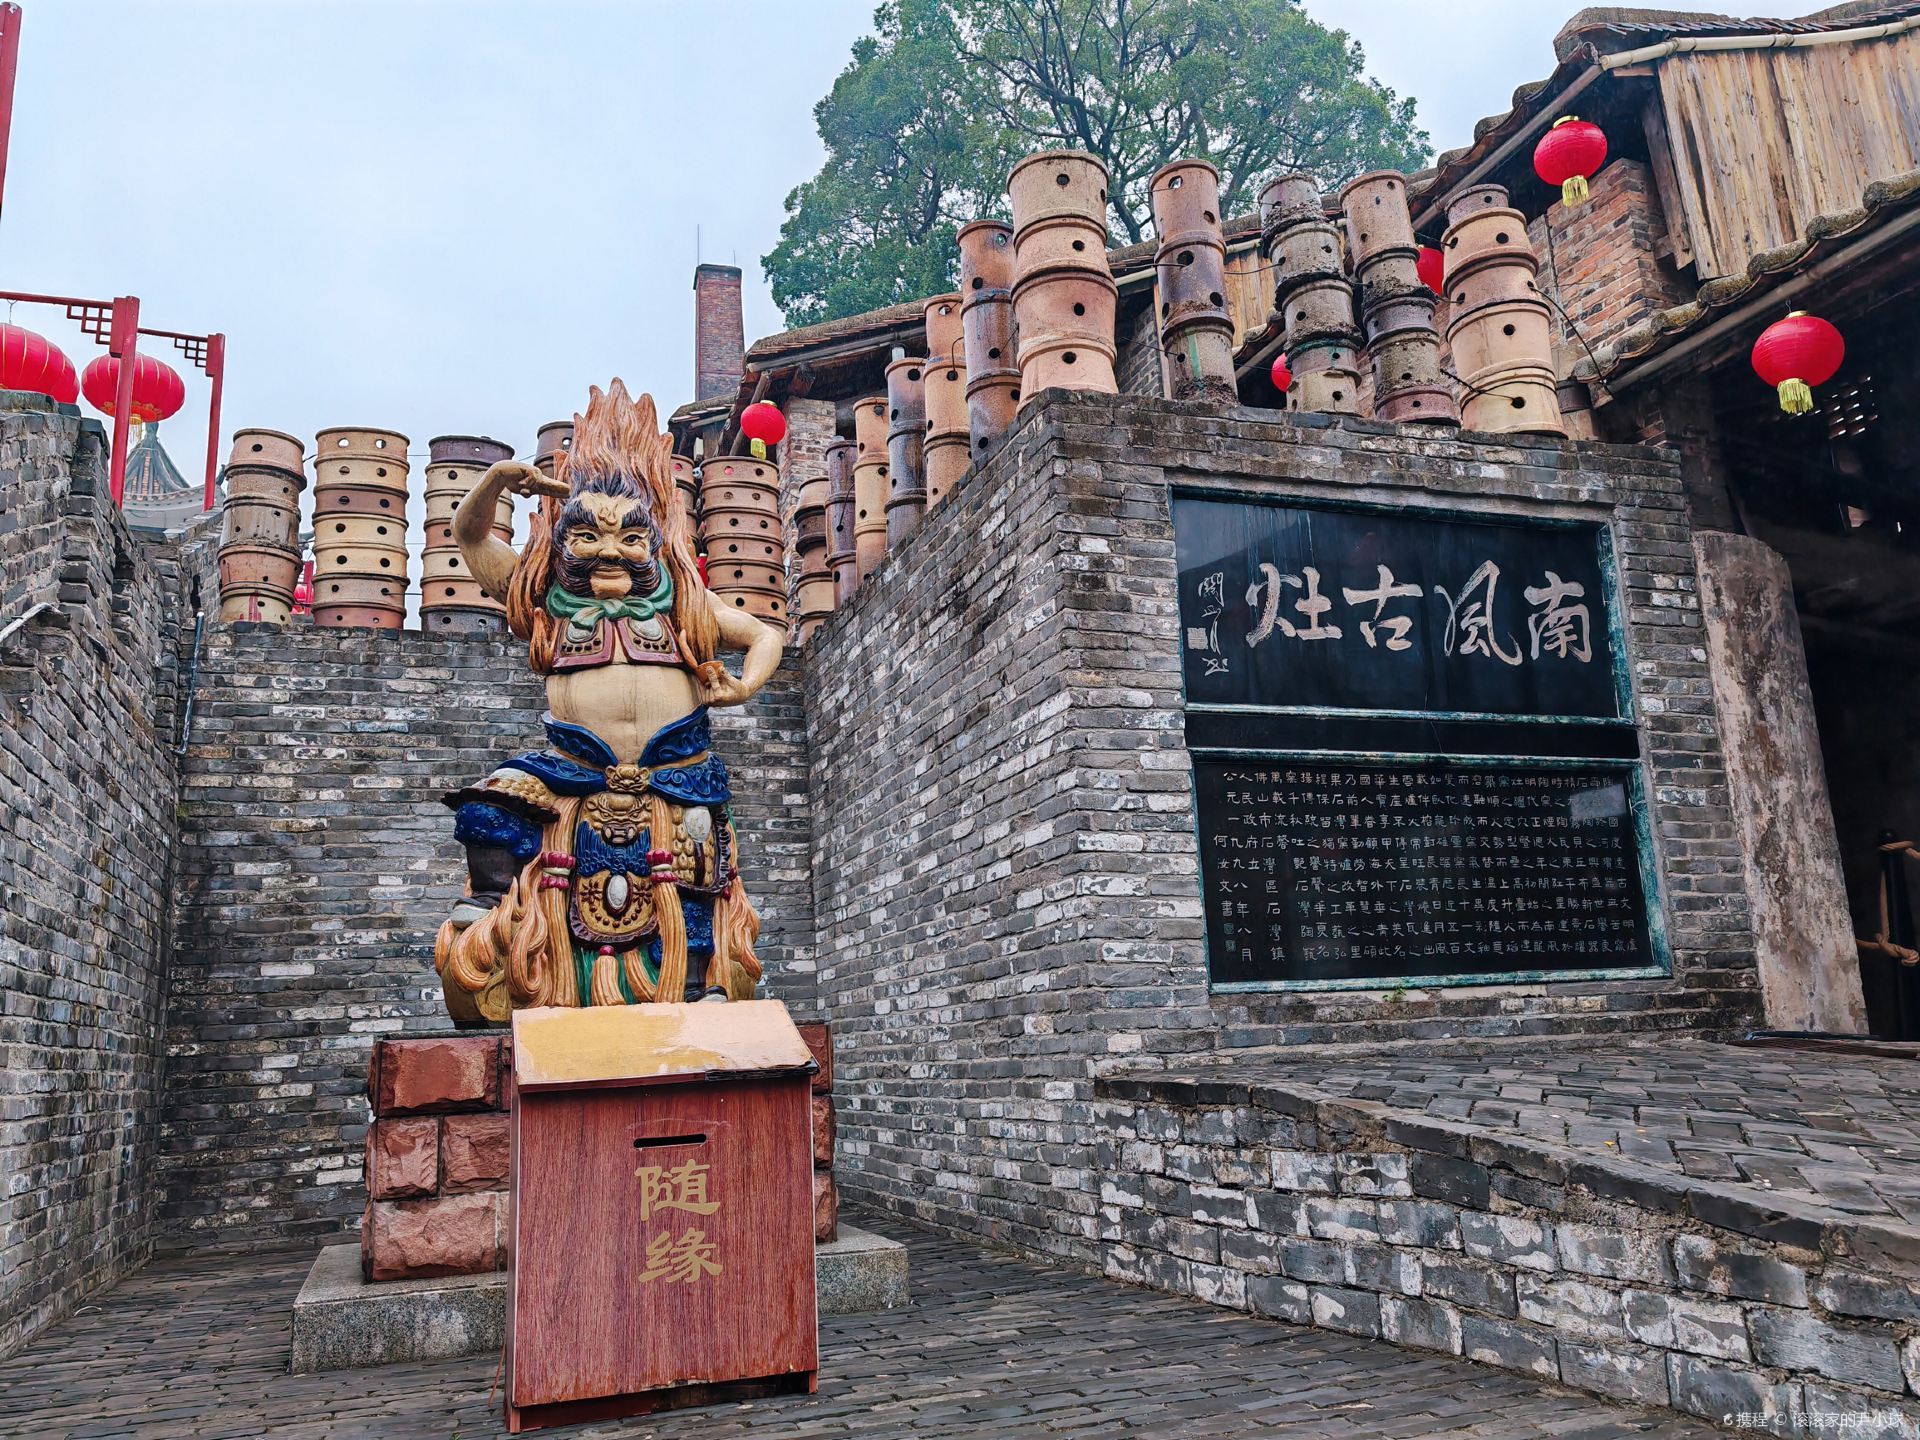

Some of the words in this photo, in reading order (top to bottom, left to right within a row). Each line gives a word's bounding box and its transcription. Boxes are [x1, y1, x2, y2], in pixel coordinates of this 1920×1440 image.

[1223, 772, 1252, 962] 公元一九九八年八月
[1239, 773, 1260, 869] 人民政府立
[1254, 772, 1285, 961] 佛山市石灣區石灣鎮
[634, 1159, 723, 1284] 随缘
